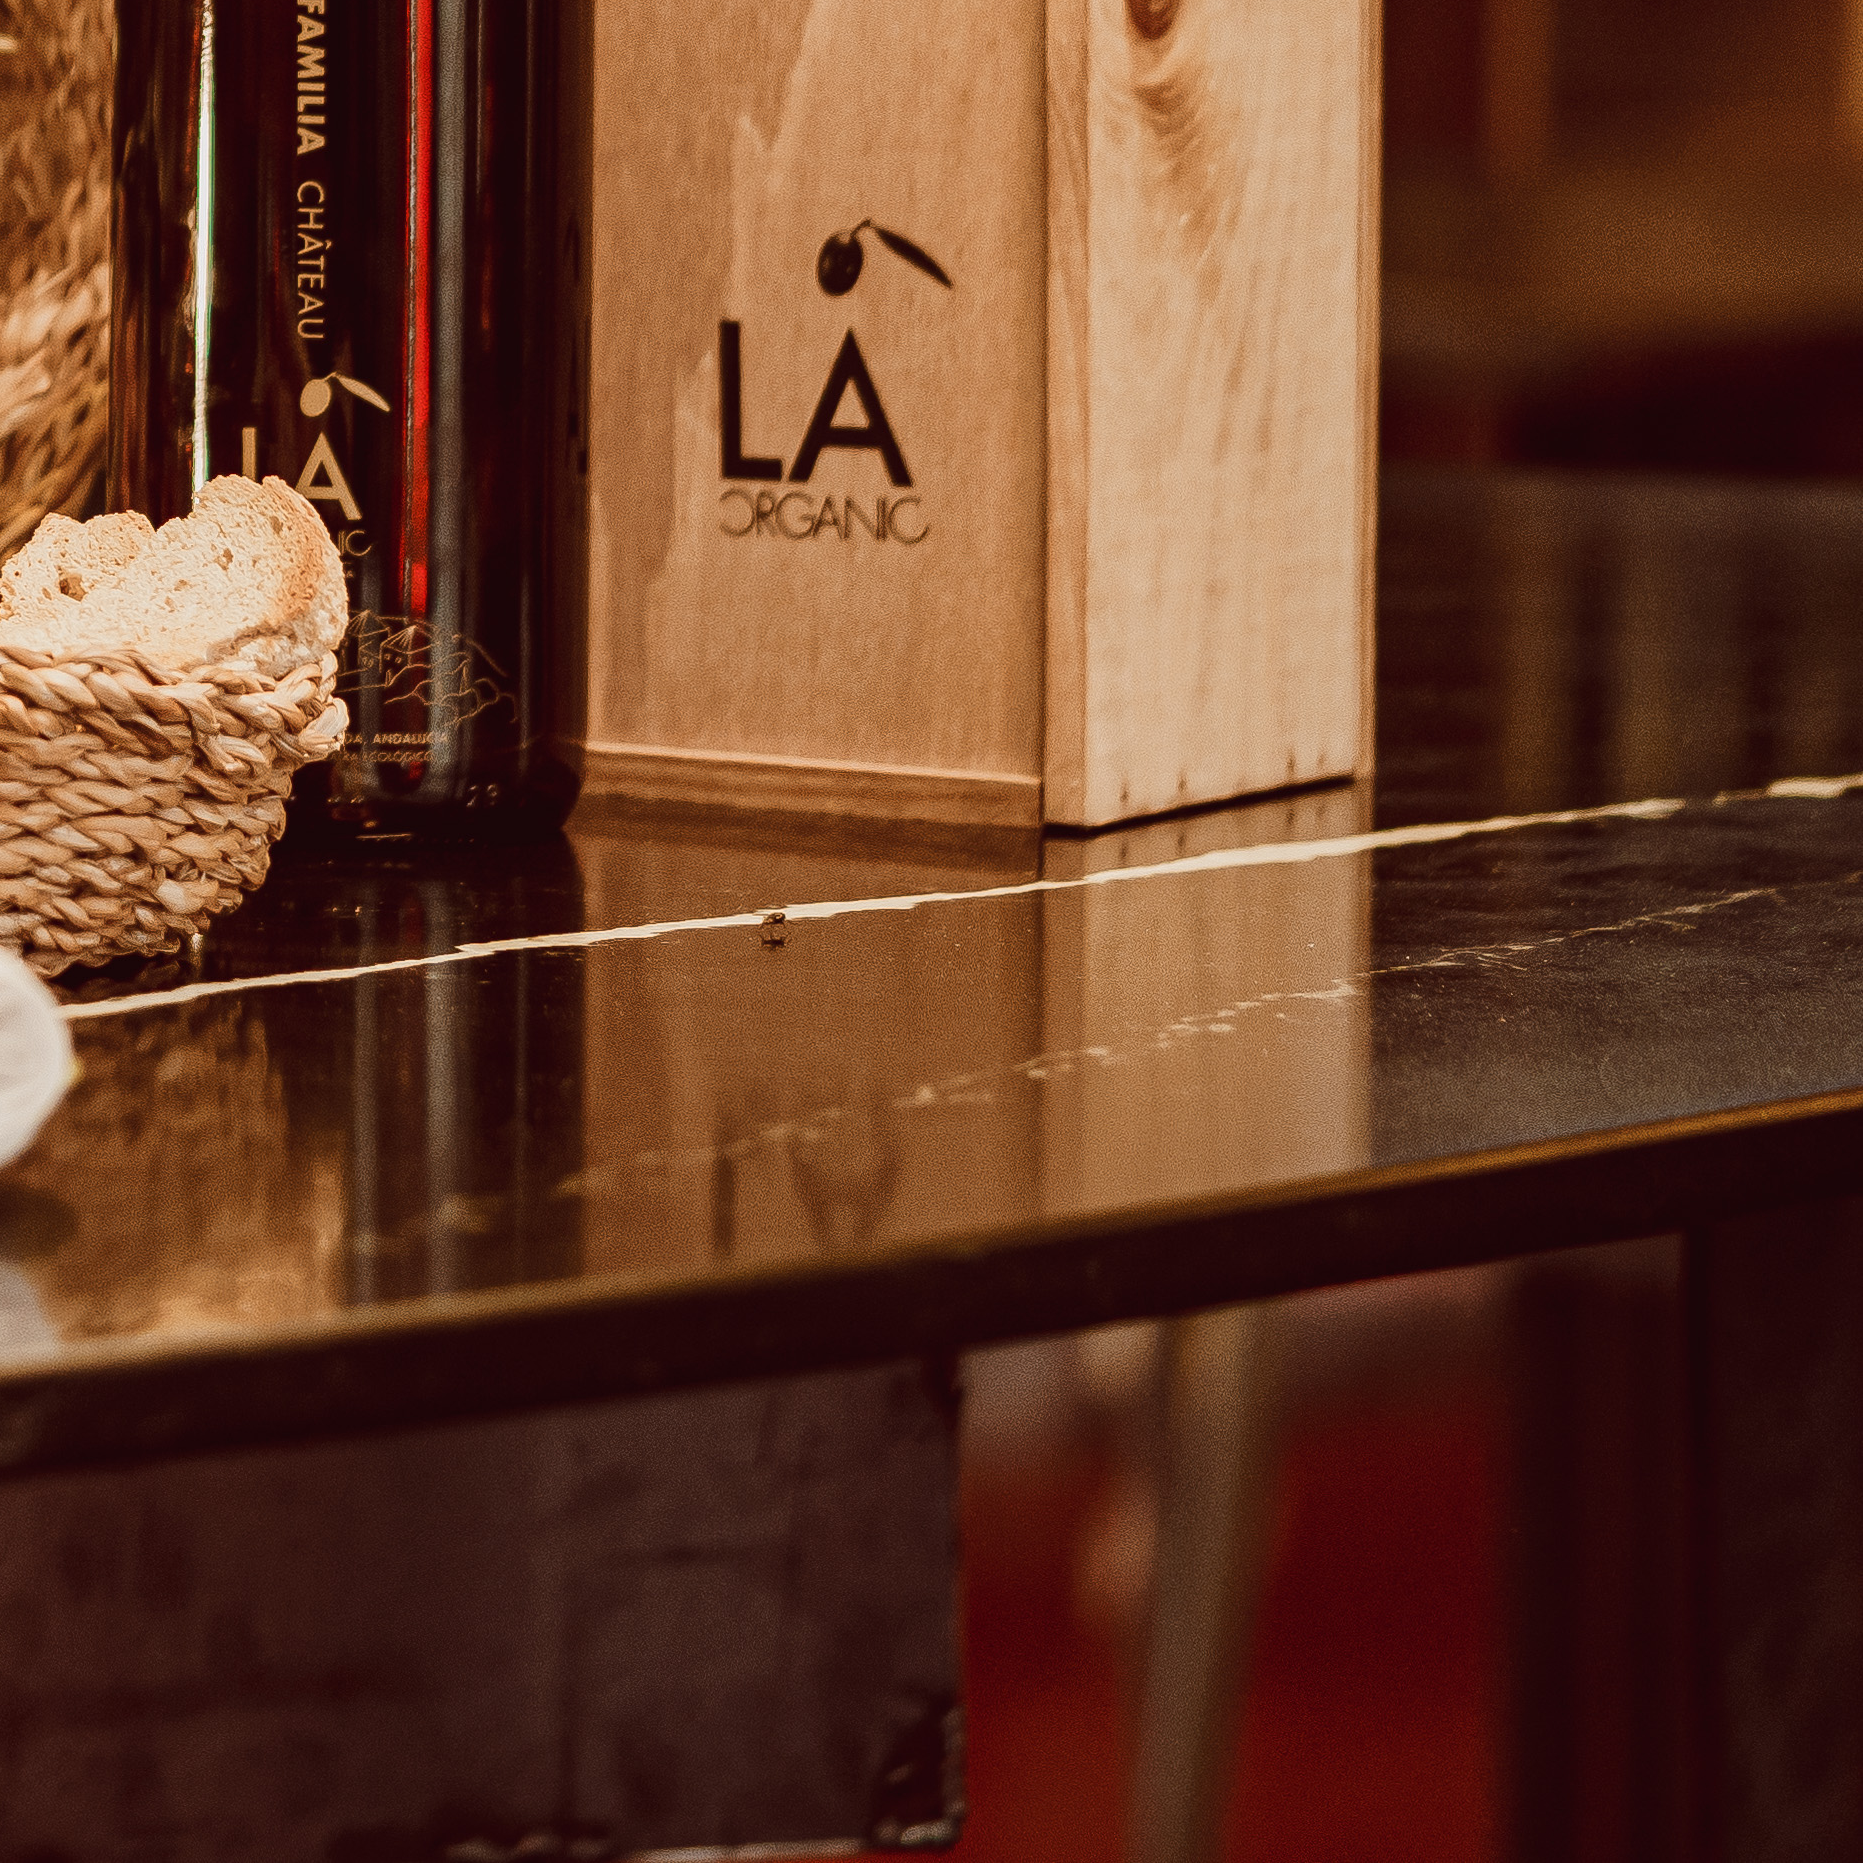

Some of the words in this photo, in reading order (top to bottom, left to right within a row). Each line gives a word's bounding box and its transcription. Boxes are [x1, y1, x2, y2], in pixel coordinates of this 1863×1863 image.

[295, 179, 334, 340] CHÂTEAU
[719, 319, 915, 488] LA
[720, 488, 931, 546] ORGANIC
